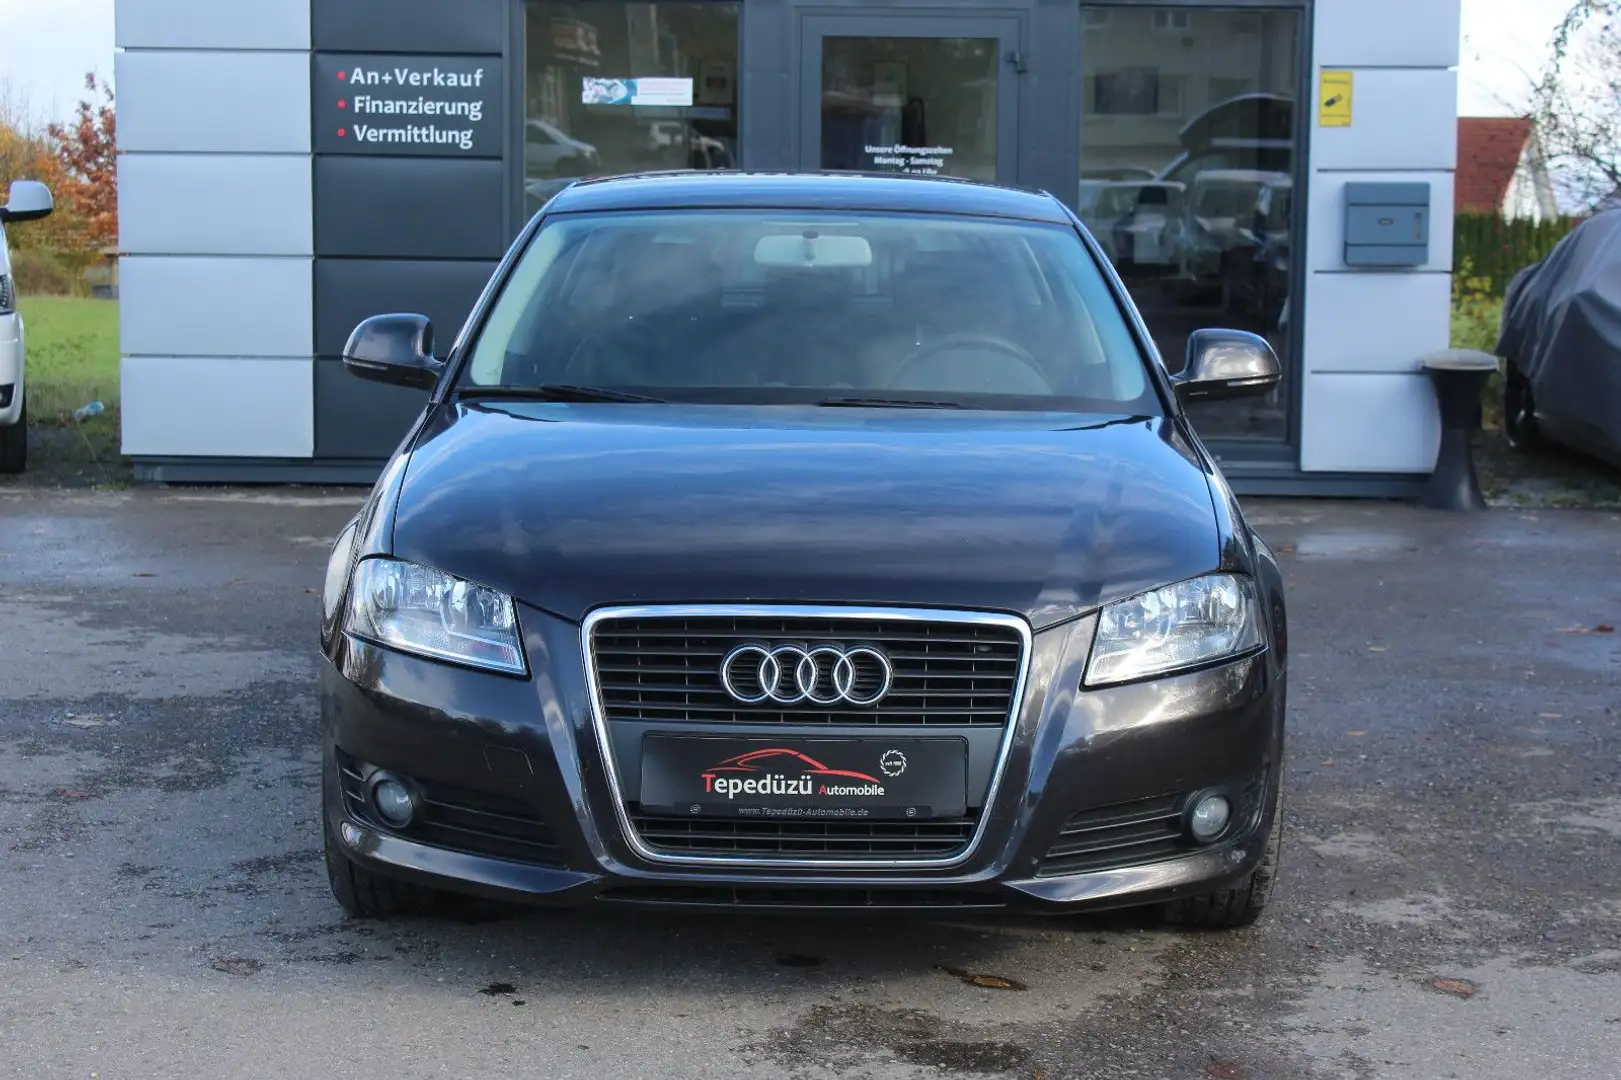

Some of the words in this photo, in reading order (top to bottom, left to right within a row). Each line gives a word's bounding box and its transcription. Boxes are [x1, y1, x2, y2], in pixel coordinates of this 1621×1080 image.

[350, 67, 484, 87] An+Verkauf
[353, 95, 483, 121] Finanzierung
[353, 124, 473, 149] Vermittlung
[865, 145, 893, 154] Unsere
[874, 156, 905, 167] Montag
[910, 156, 944, 167] Samstag
[702, 774, 813, 799] Tepedüzü
[819, 784, 885, 796] Automobile
